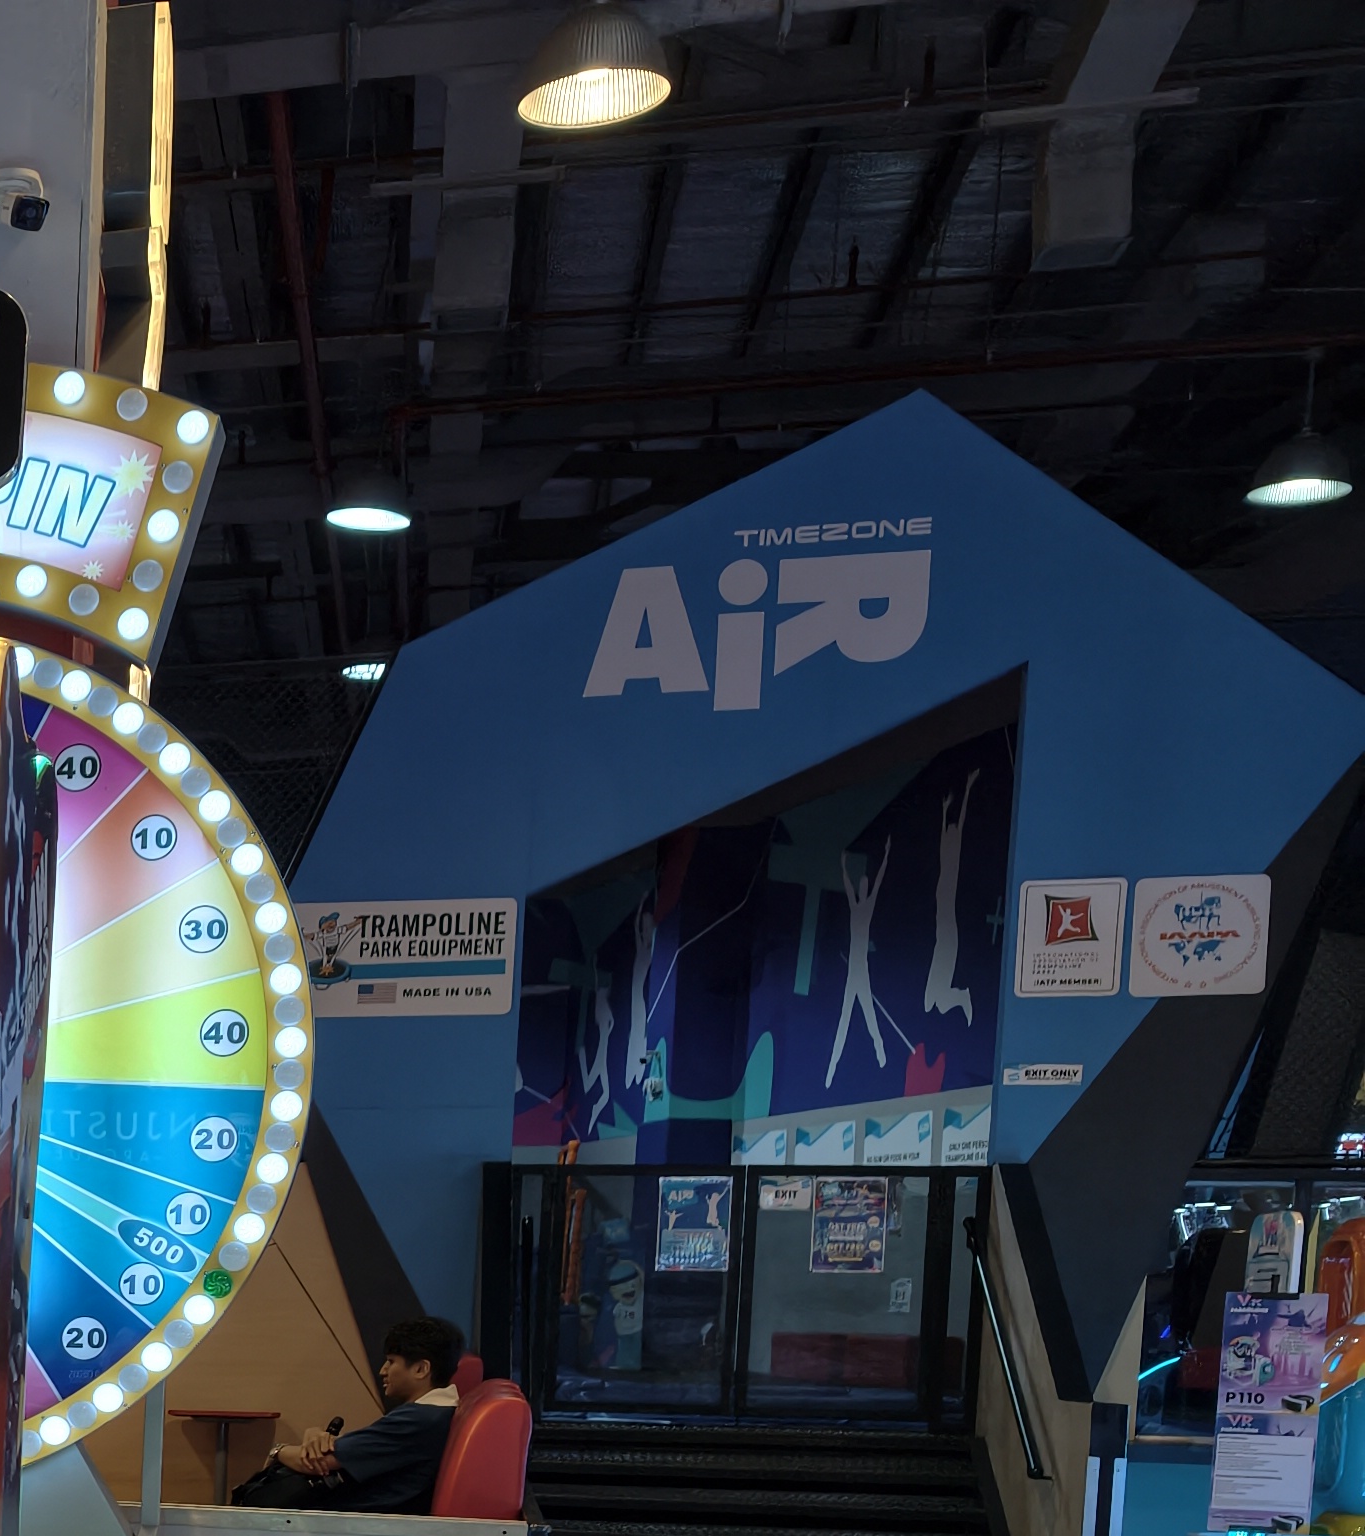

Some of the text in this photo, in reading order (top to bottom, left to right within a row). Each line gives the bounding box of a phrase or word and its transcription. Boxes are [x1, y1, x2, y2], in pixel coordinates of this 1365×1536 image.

[734, 517, 932, 547] TIMEZONE
[56, 756, 98, 780] 40
[134, 828, 174, 850] 10
[183, 920, 226, 940] 30
[360, 911, 507, 938] TRAMPOLINE
[359, 938, 505, 958] PARK EQUIPMENT
[402, 986, 492, 998] MADE IN USA
[203, 1022, 246, 1045] 40
[1024, 1069, 1048, 1079] EXIT
[1050, 1069, 1080, 1078] ONLY
[194, 1128, 235, 1150] 20
[774, 1189, 798, 1200] EXIT
[169, 1204, 207, 1224] 10
[133, 1229, 184, 1265] 500
[122, 1275, 161, 1295] 10
[65, 1327, 105, 1349] 20
[1225, 1391, 1265, 1404] P110
[1226, 1414, 1254, 1427] VR
